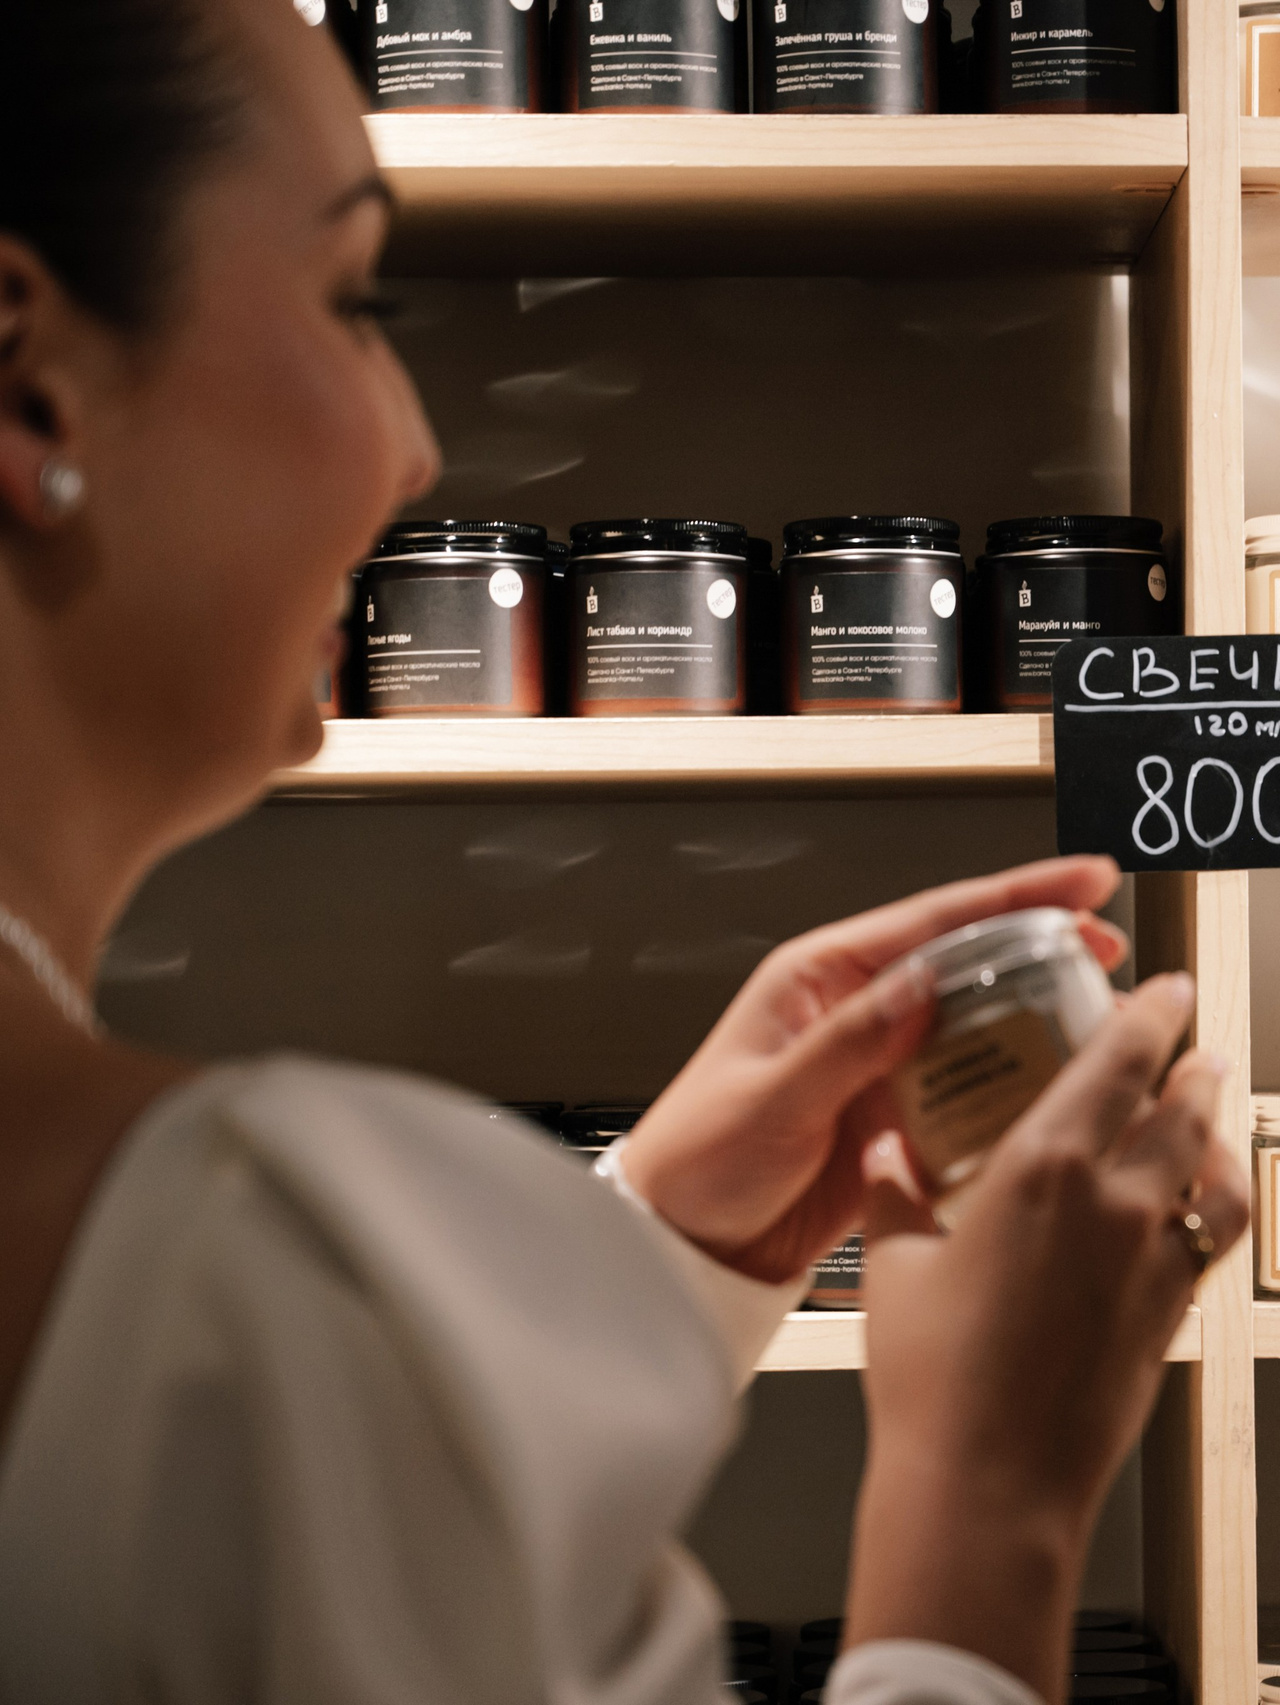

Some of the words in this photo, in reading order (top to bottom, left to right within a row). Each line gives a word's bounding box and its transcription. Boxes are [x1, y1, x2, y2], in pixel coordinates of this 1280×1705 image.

[411, 32, 430, 42] мох
[431, 32, 440, 41] и
[441, 29, 472, 42] амбра
[589, 33, 626, 46] Ежевика
[627, 33, 635, 42] и
[636, 33, 673, 43] ваниль
[824, 32, 853, 43] груша
[855, 32, 863, 41] и
[864, 30, 898, 43] бренди
[1010, 31, 1038, 42] Инжир
[1039, 30, 1046, 39] и
[1048, 28, 1094, 40] карамель
[587, 626, 604, 637] Лист
[606, 625, 636, 637] табака
[638, 626, 645, 635] и
[647, 626, 692, 637] кориандр
[811, 626, 837, 637] Манго
[839, 626, 845, 635] и
[848, 626, 893, 635] кокосовое
[896, 626, 928, 635] молоко
[1018, 620, 1060, 632] Маракуйя
[1063, 621, 1069, 630] и
[1072, 621, 1101, 630] манго
[387, 633, 412, 645] ягоды
[1194, 711, 1248, 736] 120
